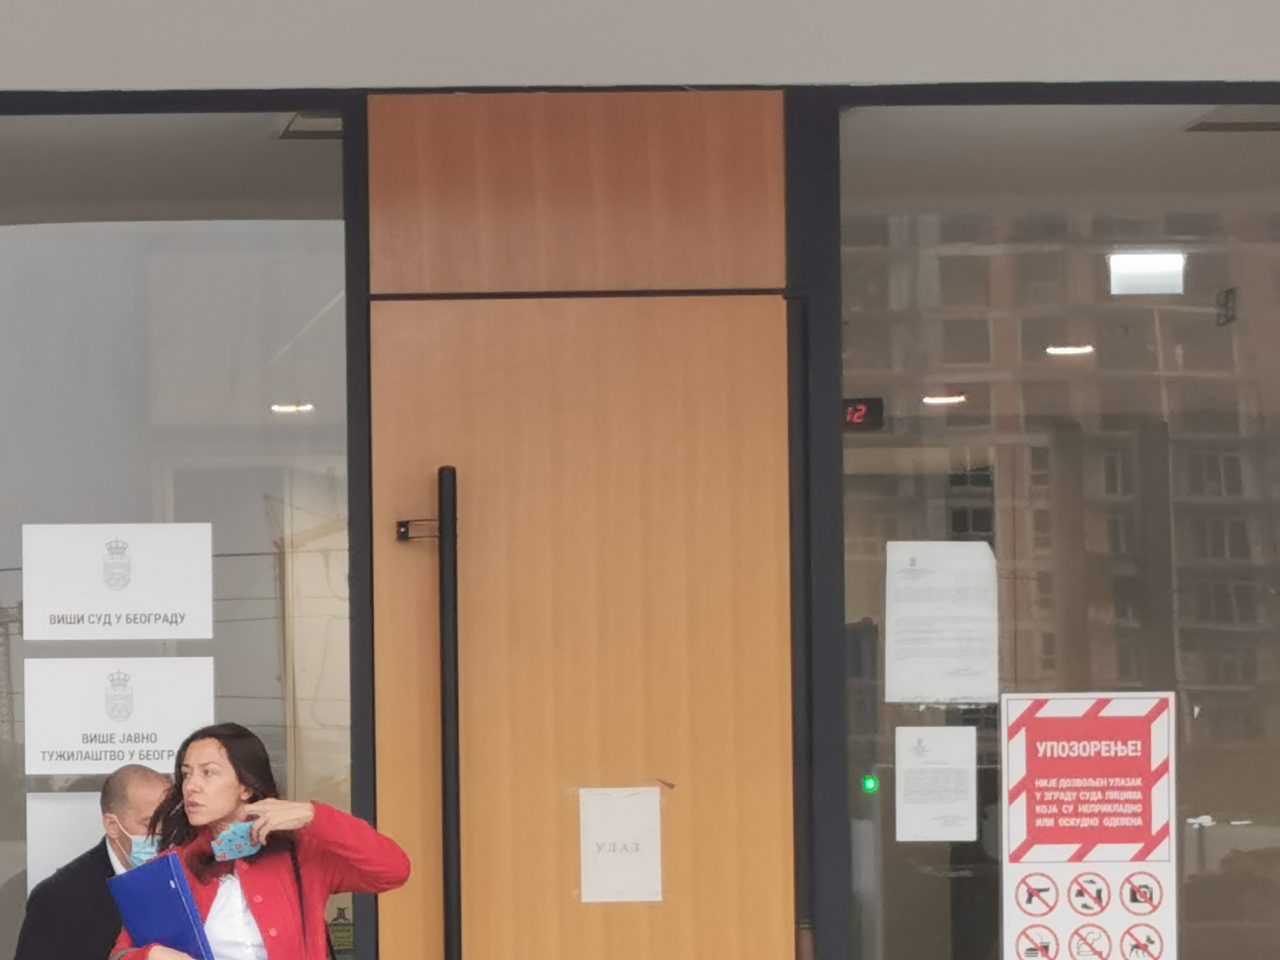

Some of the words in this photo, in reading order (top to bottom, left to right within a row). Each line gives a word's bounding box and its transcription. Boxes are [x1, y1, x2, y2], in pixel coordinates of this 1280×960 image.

[49, 613, 85, 625] ВИШИ
[87, 613, 112, 626] СУД
[115, 613, 123, 625] У
[125, 612, 186, 626] БЕОГРАДУ
[81, 732, 116, 744] ВИШЕ
[118, 732, 158, 744] ЈАВНО
[40, 750, 125, 761] ТУЖИЛАШТВО
[129, 749, 136, 761] У
[138, 749, 176, 761] БЕОГР
[1035, 740, 1142, 758] УПОЗОРЕЊЕ!
[1108, 777, 1142, 787] УЛАЗАК
[1035, 791, 1042, 800] У
[1043, 791, 1077, 801] ЗГРАДУ
[1079, 791, 1103, 802] СУДА
[1062, 804, 1074, 814] СУ
